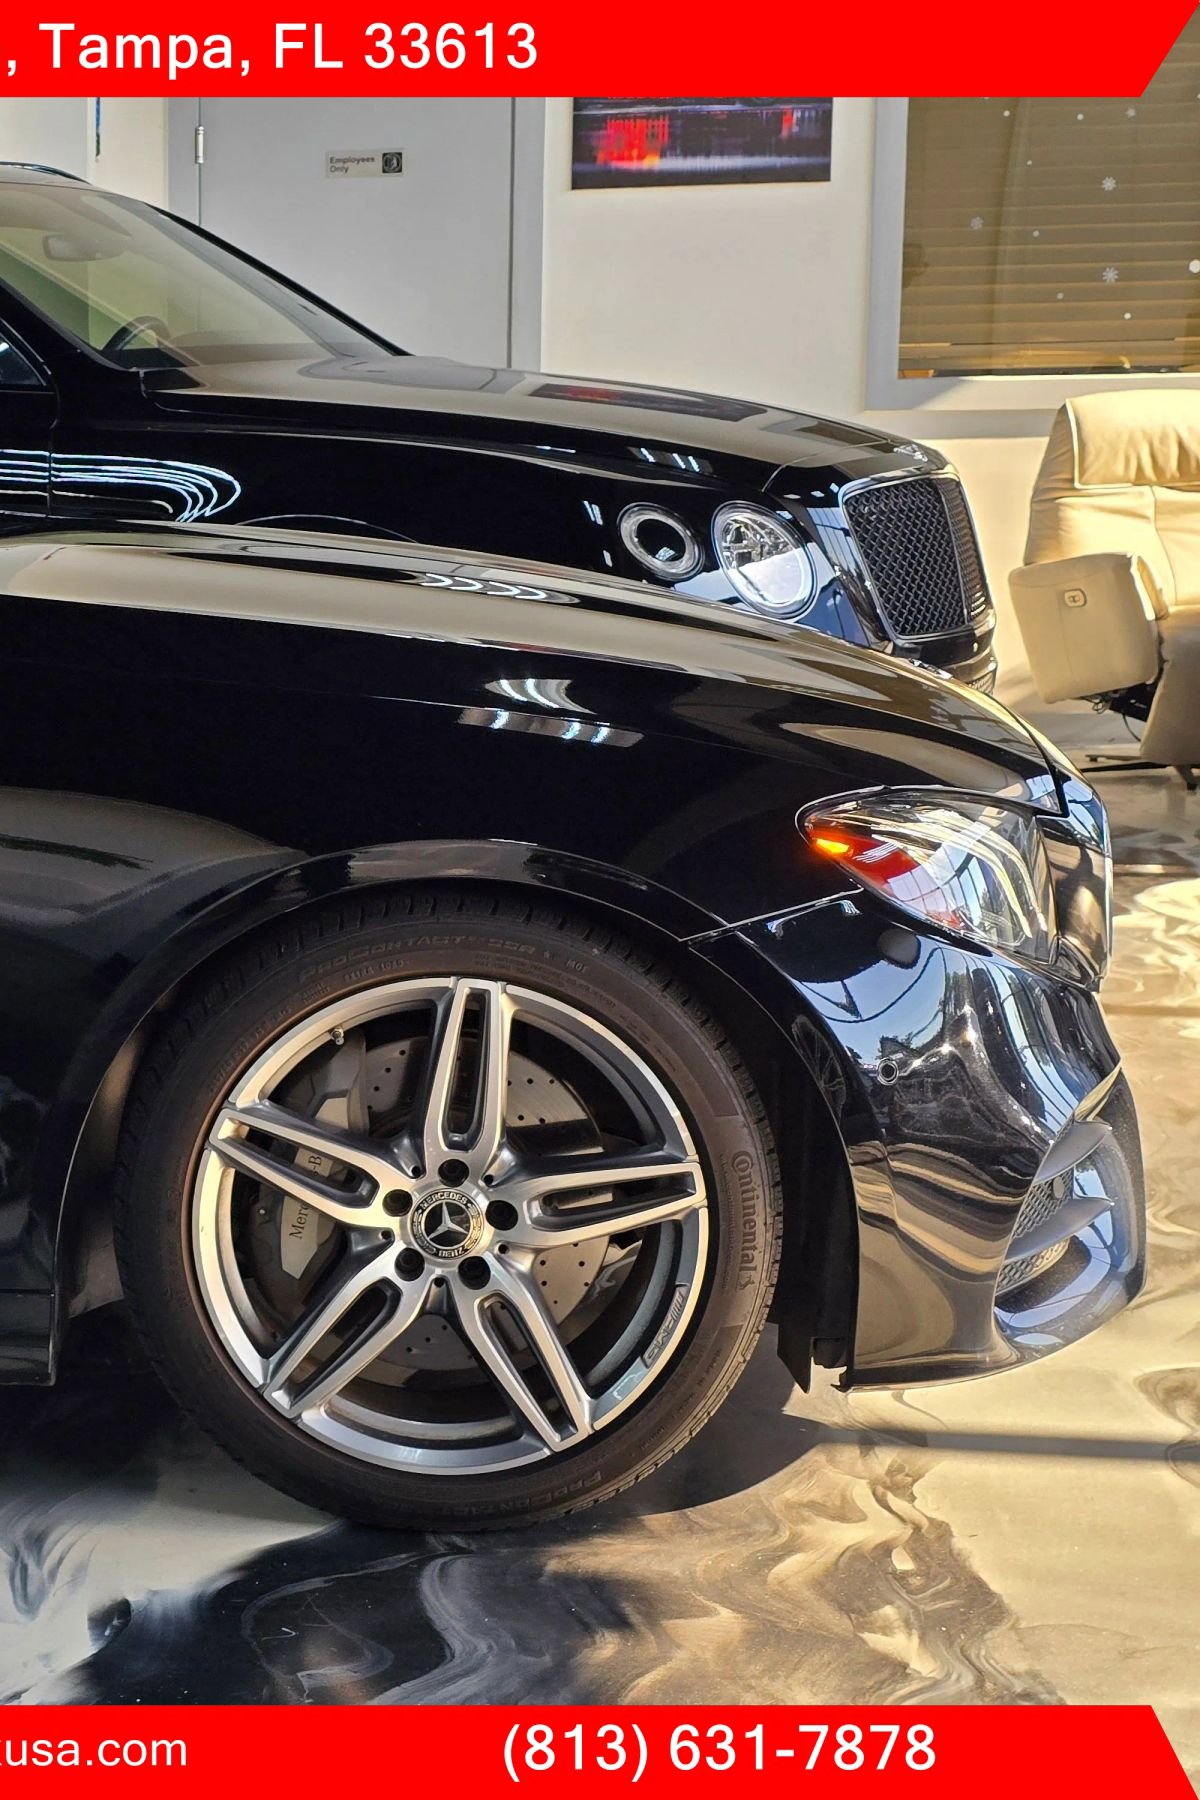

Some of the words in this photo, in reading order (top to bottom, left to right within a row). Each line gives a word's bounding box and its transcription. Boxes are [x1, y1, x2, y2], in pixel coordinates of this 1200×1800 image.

[328, 156, 376, 165] Employees
[328, 165, 350, 174] Only
[420, 1191, 469, 1210] MERCEDES
[731, 1151, 760, 1272] Continental
